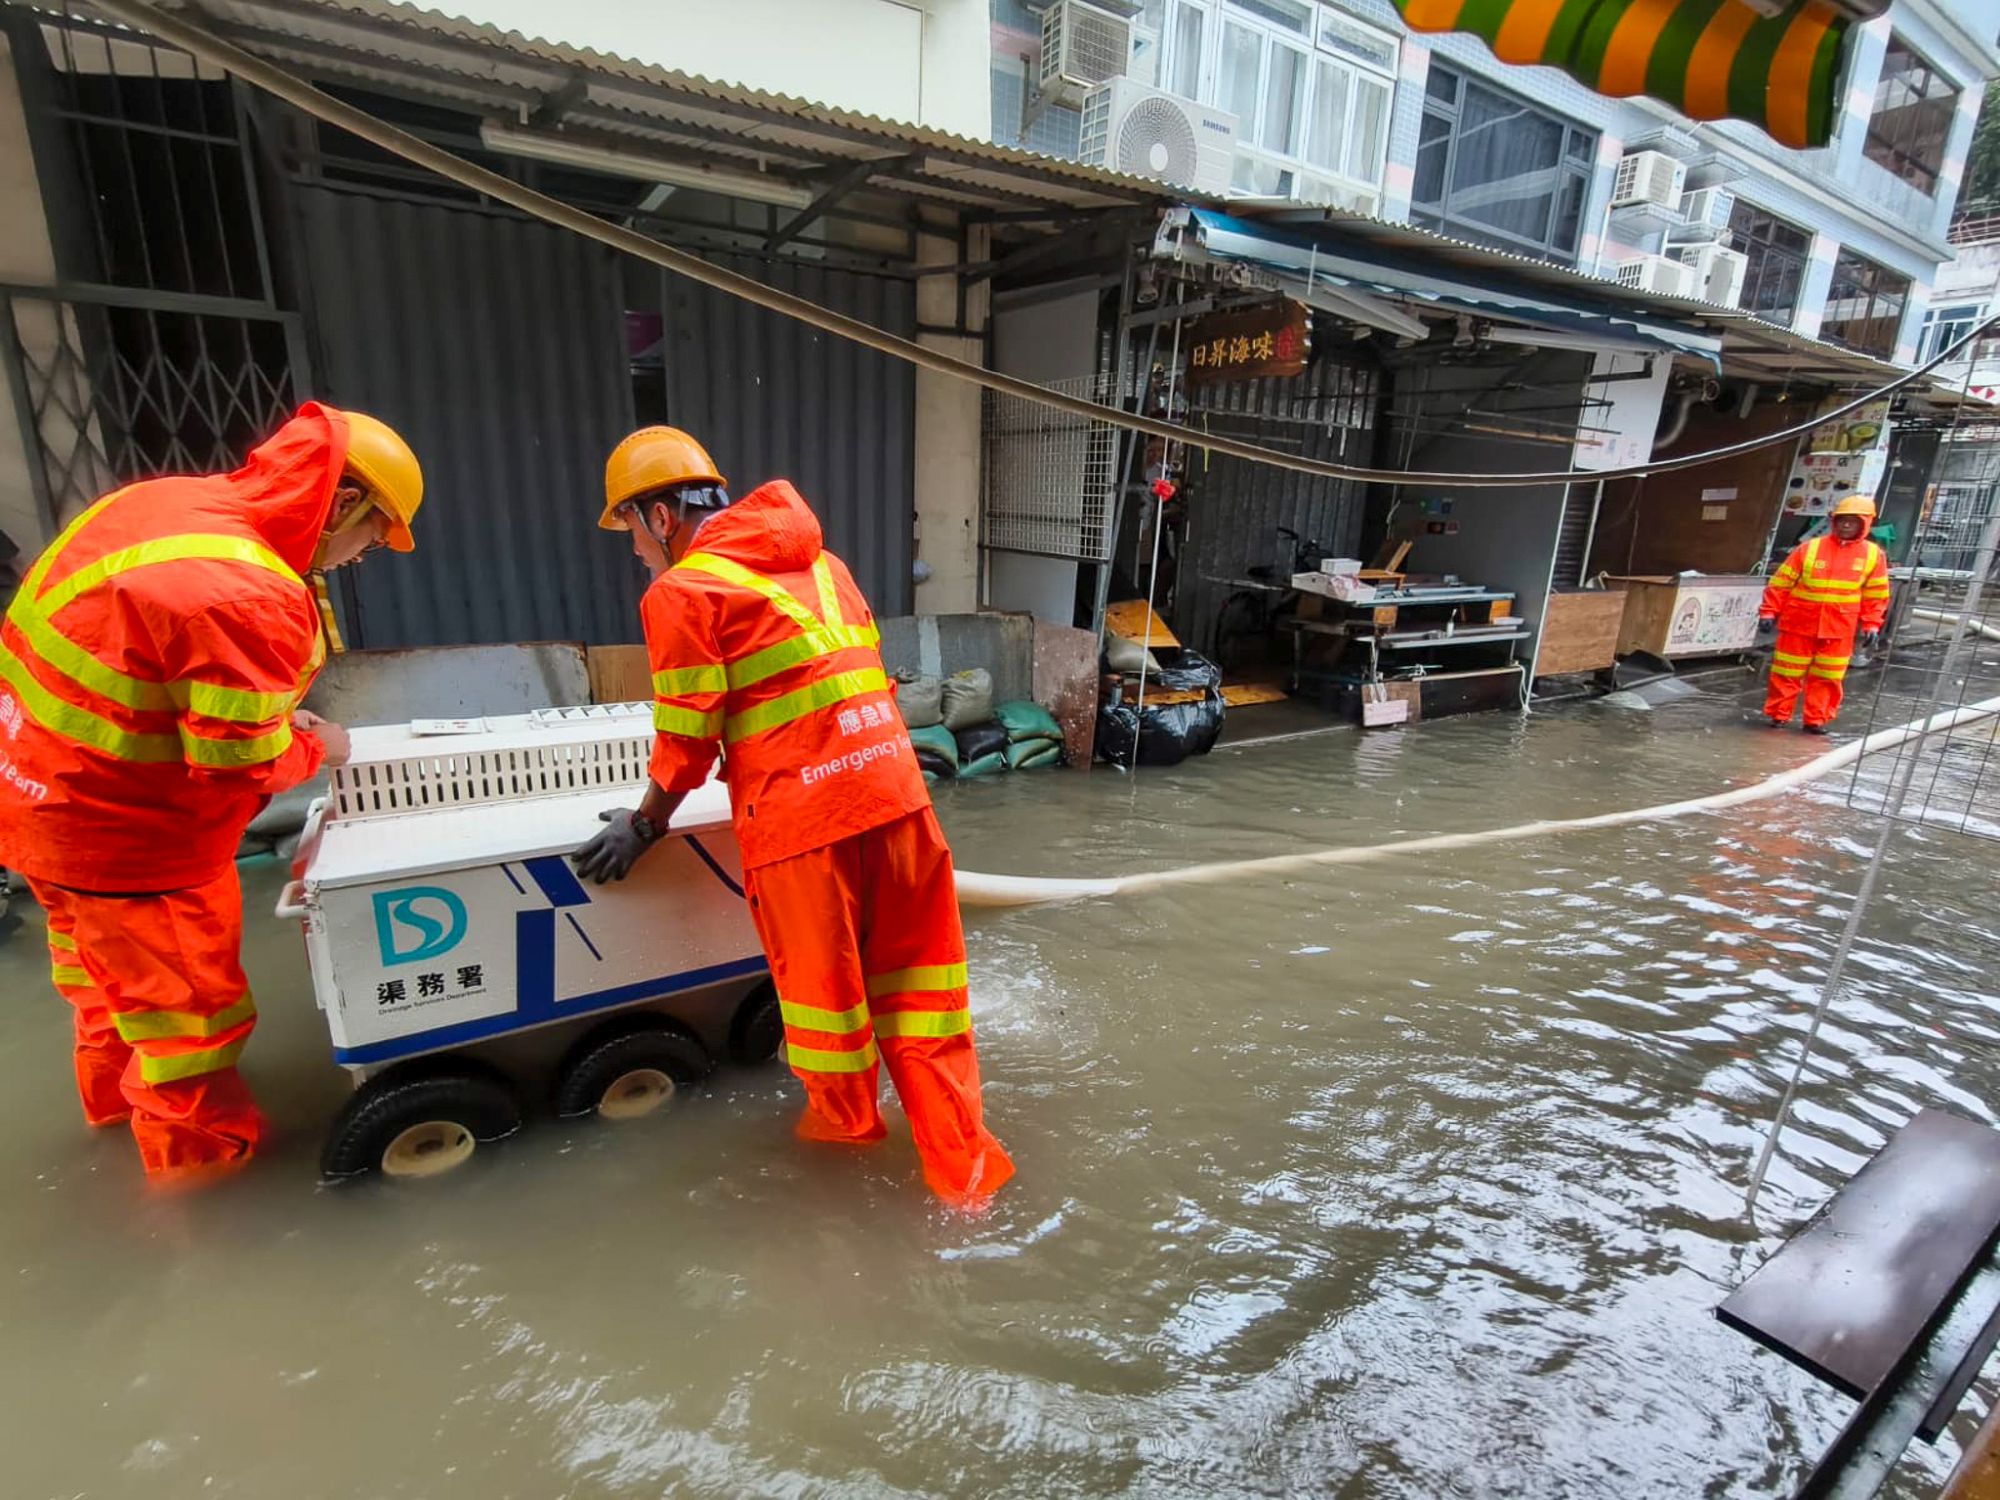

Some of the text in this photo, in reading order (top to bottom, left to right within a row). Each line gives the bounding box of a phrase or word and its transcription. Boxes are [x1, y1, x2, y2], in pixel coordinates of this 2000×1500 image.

[1203, 119, 1231, 135] SAMSUNG
[800, 740, 899, 785] Emergency
[376, 964, 484, 1006] 渠務署
